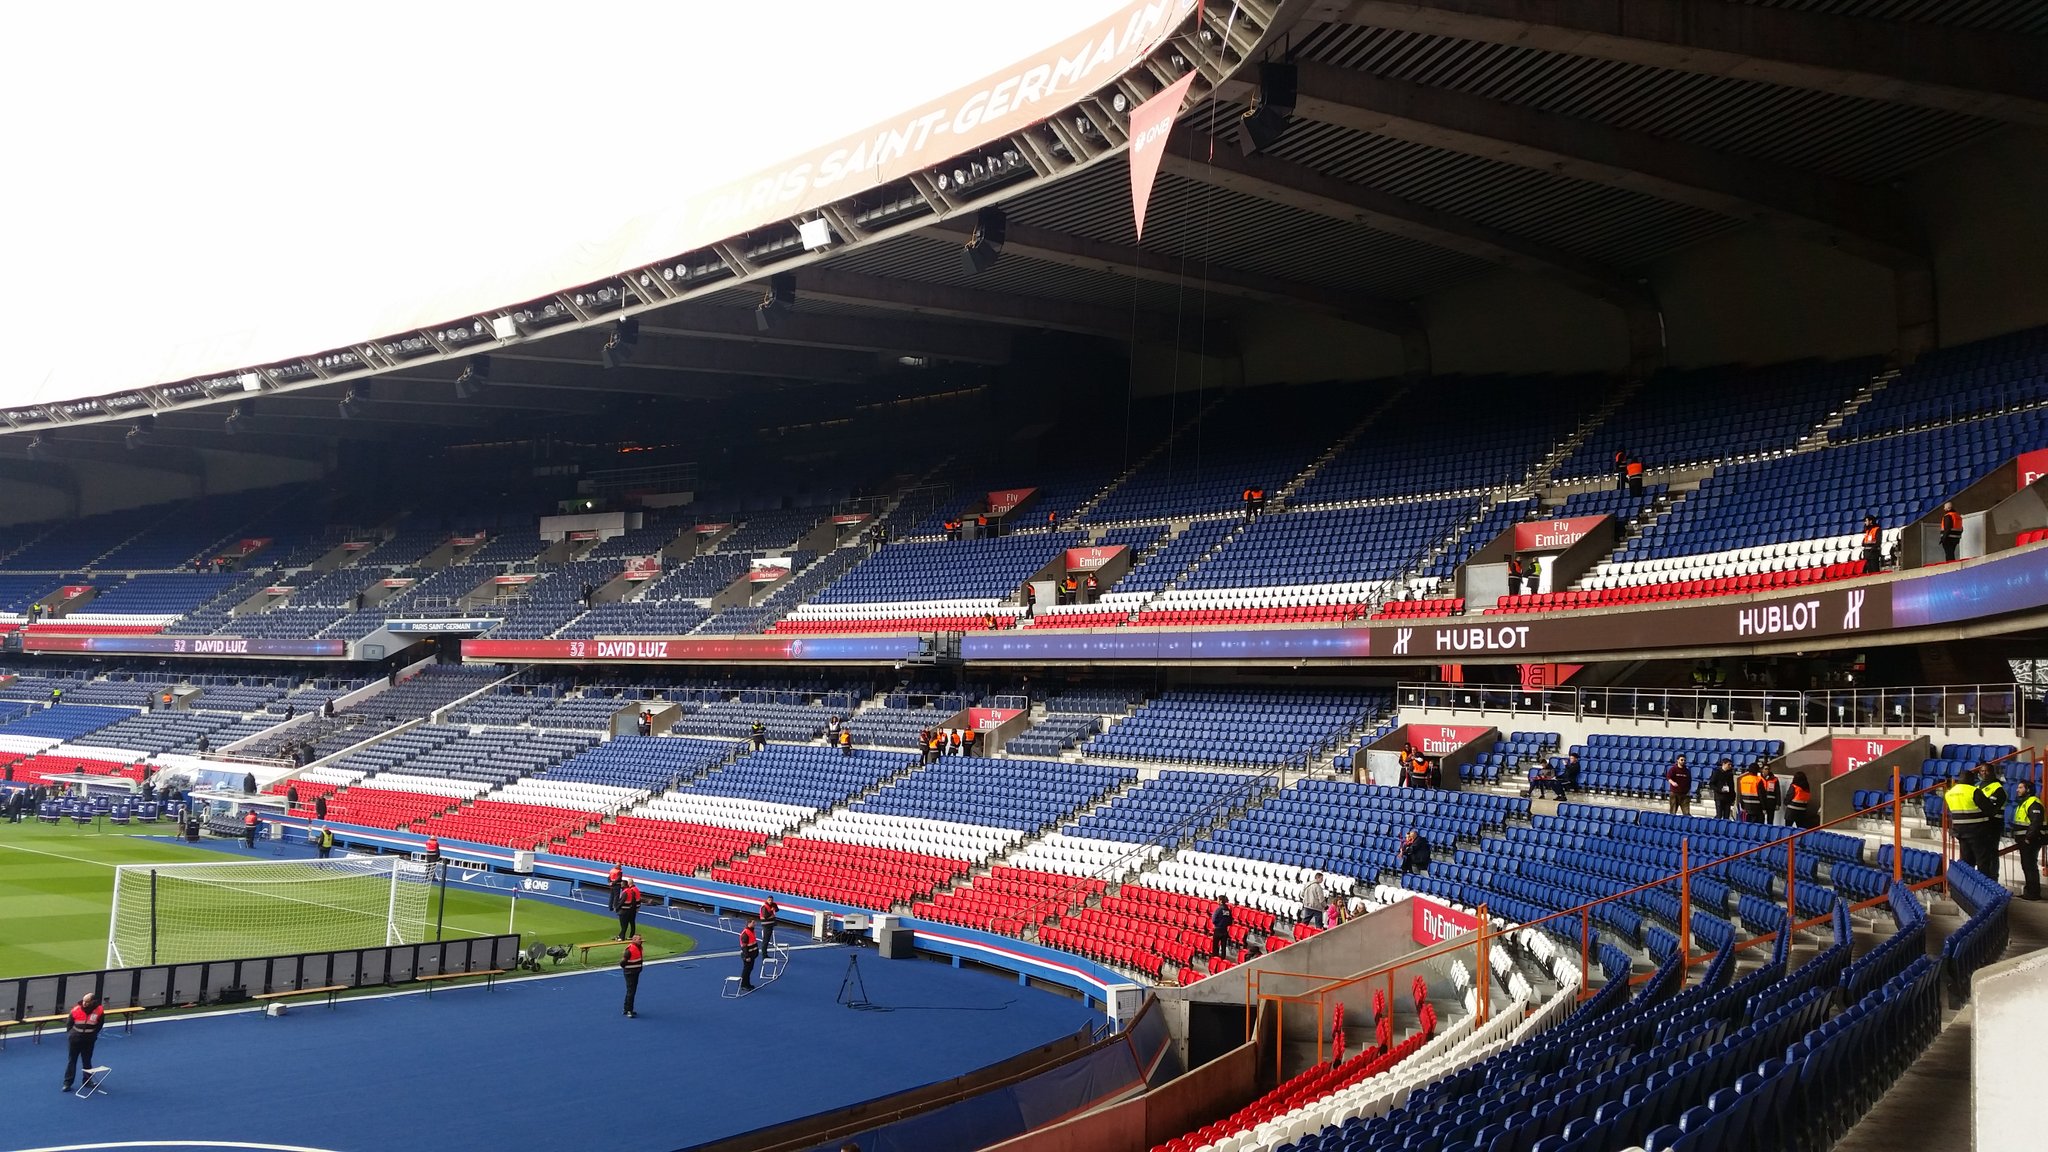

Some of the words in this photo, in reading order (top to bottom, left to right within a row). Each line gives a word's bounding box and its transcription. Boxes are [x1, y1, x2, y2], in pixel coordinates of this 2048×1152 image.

[812, 0, 1169, 188] SAINT-GERMAIN
[1146, 116, 1170, 143] QNB
[1006, 493, 1019, 503] Fly
[1554, 521, 1569, 532] Fly
[1091, 548, 1102, 557] Fly
[1079, 557, 1111, 567] Emirate
[1739, 600, 1820, 636] HUBLOT
[428, 622, 471, 630] SAINT-GERMAIN
[1436, 626, 1530, 651] HUBLOT
[194, 640, 225, 653] DAVID
[225, 640, 248, 653] LUIZ
[597, 641, 636, 658] DAVID
[637, 641, 668, 658] LUIZ
[991, 710, 1002, 719] Fly
[1441, 727, 1456, 739] Fly
[1423, 738, 1467, 753] Emirat
[1867, 741, 1883, 757] Fly
[532, 879, 549, 891] QNB
